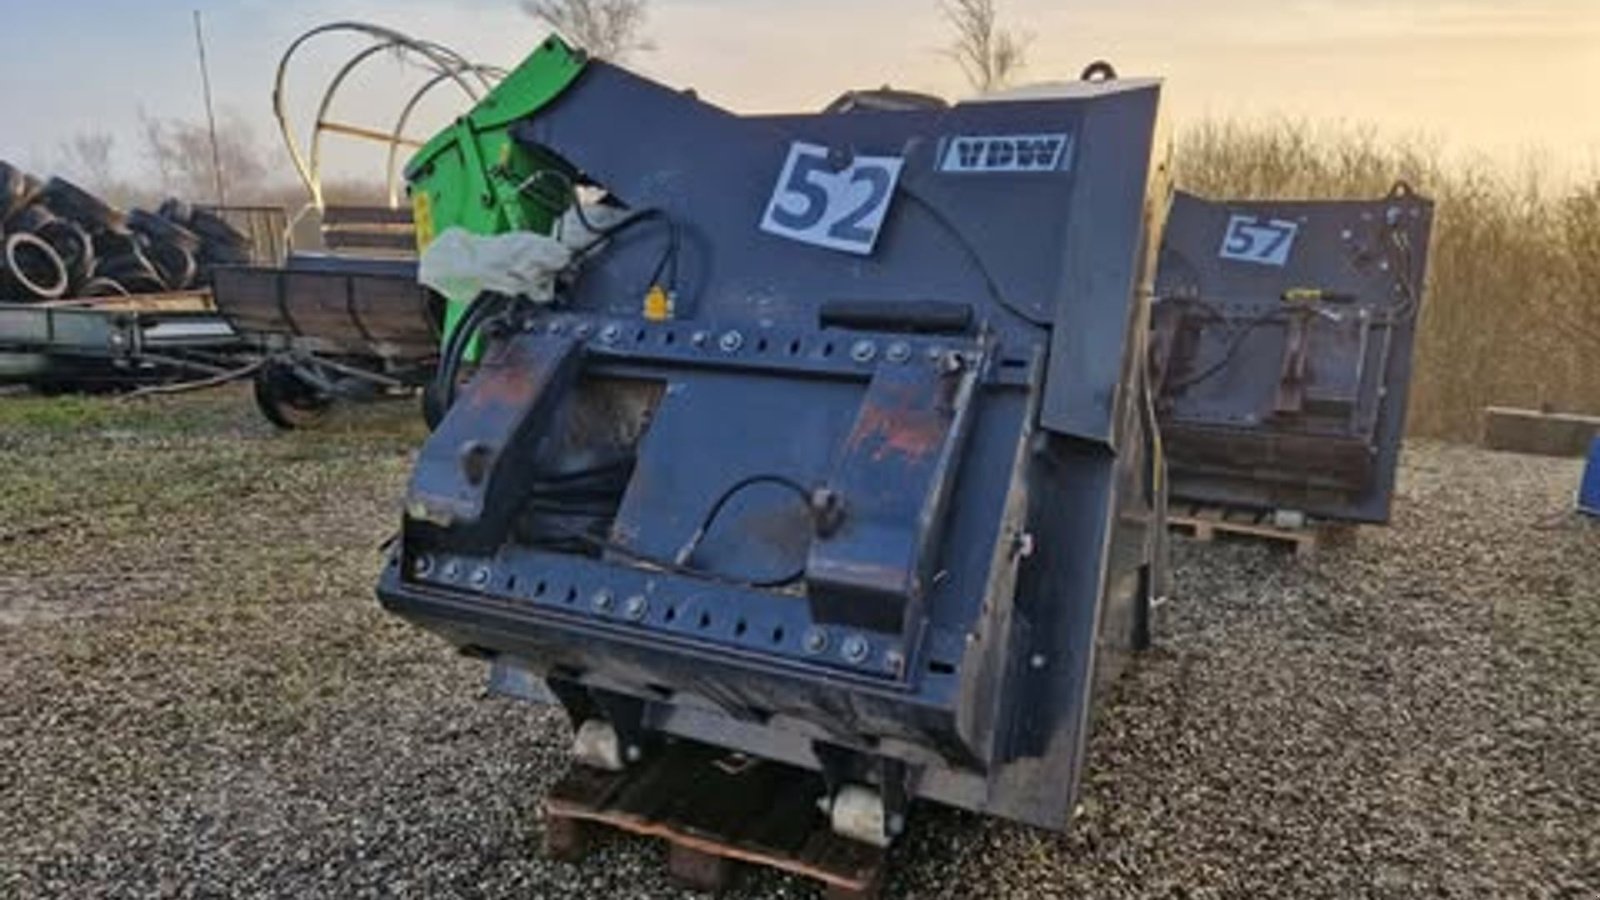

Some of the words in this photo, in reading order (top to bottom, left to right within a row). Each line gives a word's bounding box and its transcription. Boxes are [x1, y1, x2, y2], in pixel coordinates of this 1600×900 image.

[958, 139, 1061, 167] VDW
[771, 153, 891, 244] 52
[1226, 220, 1290, 258] 57
